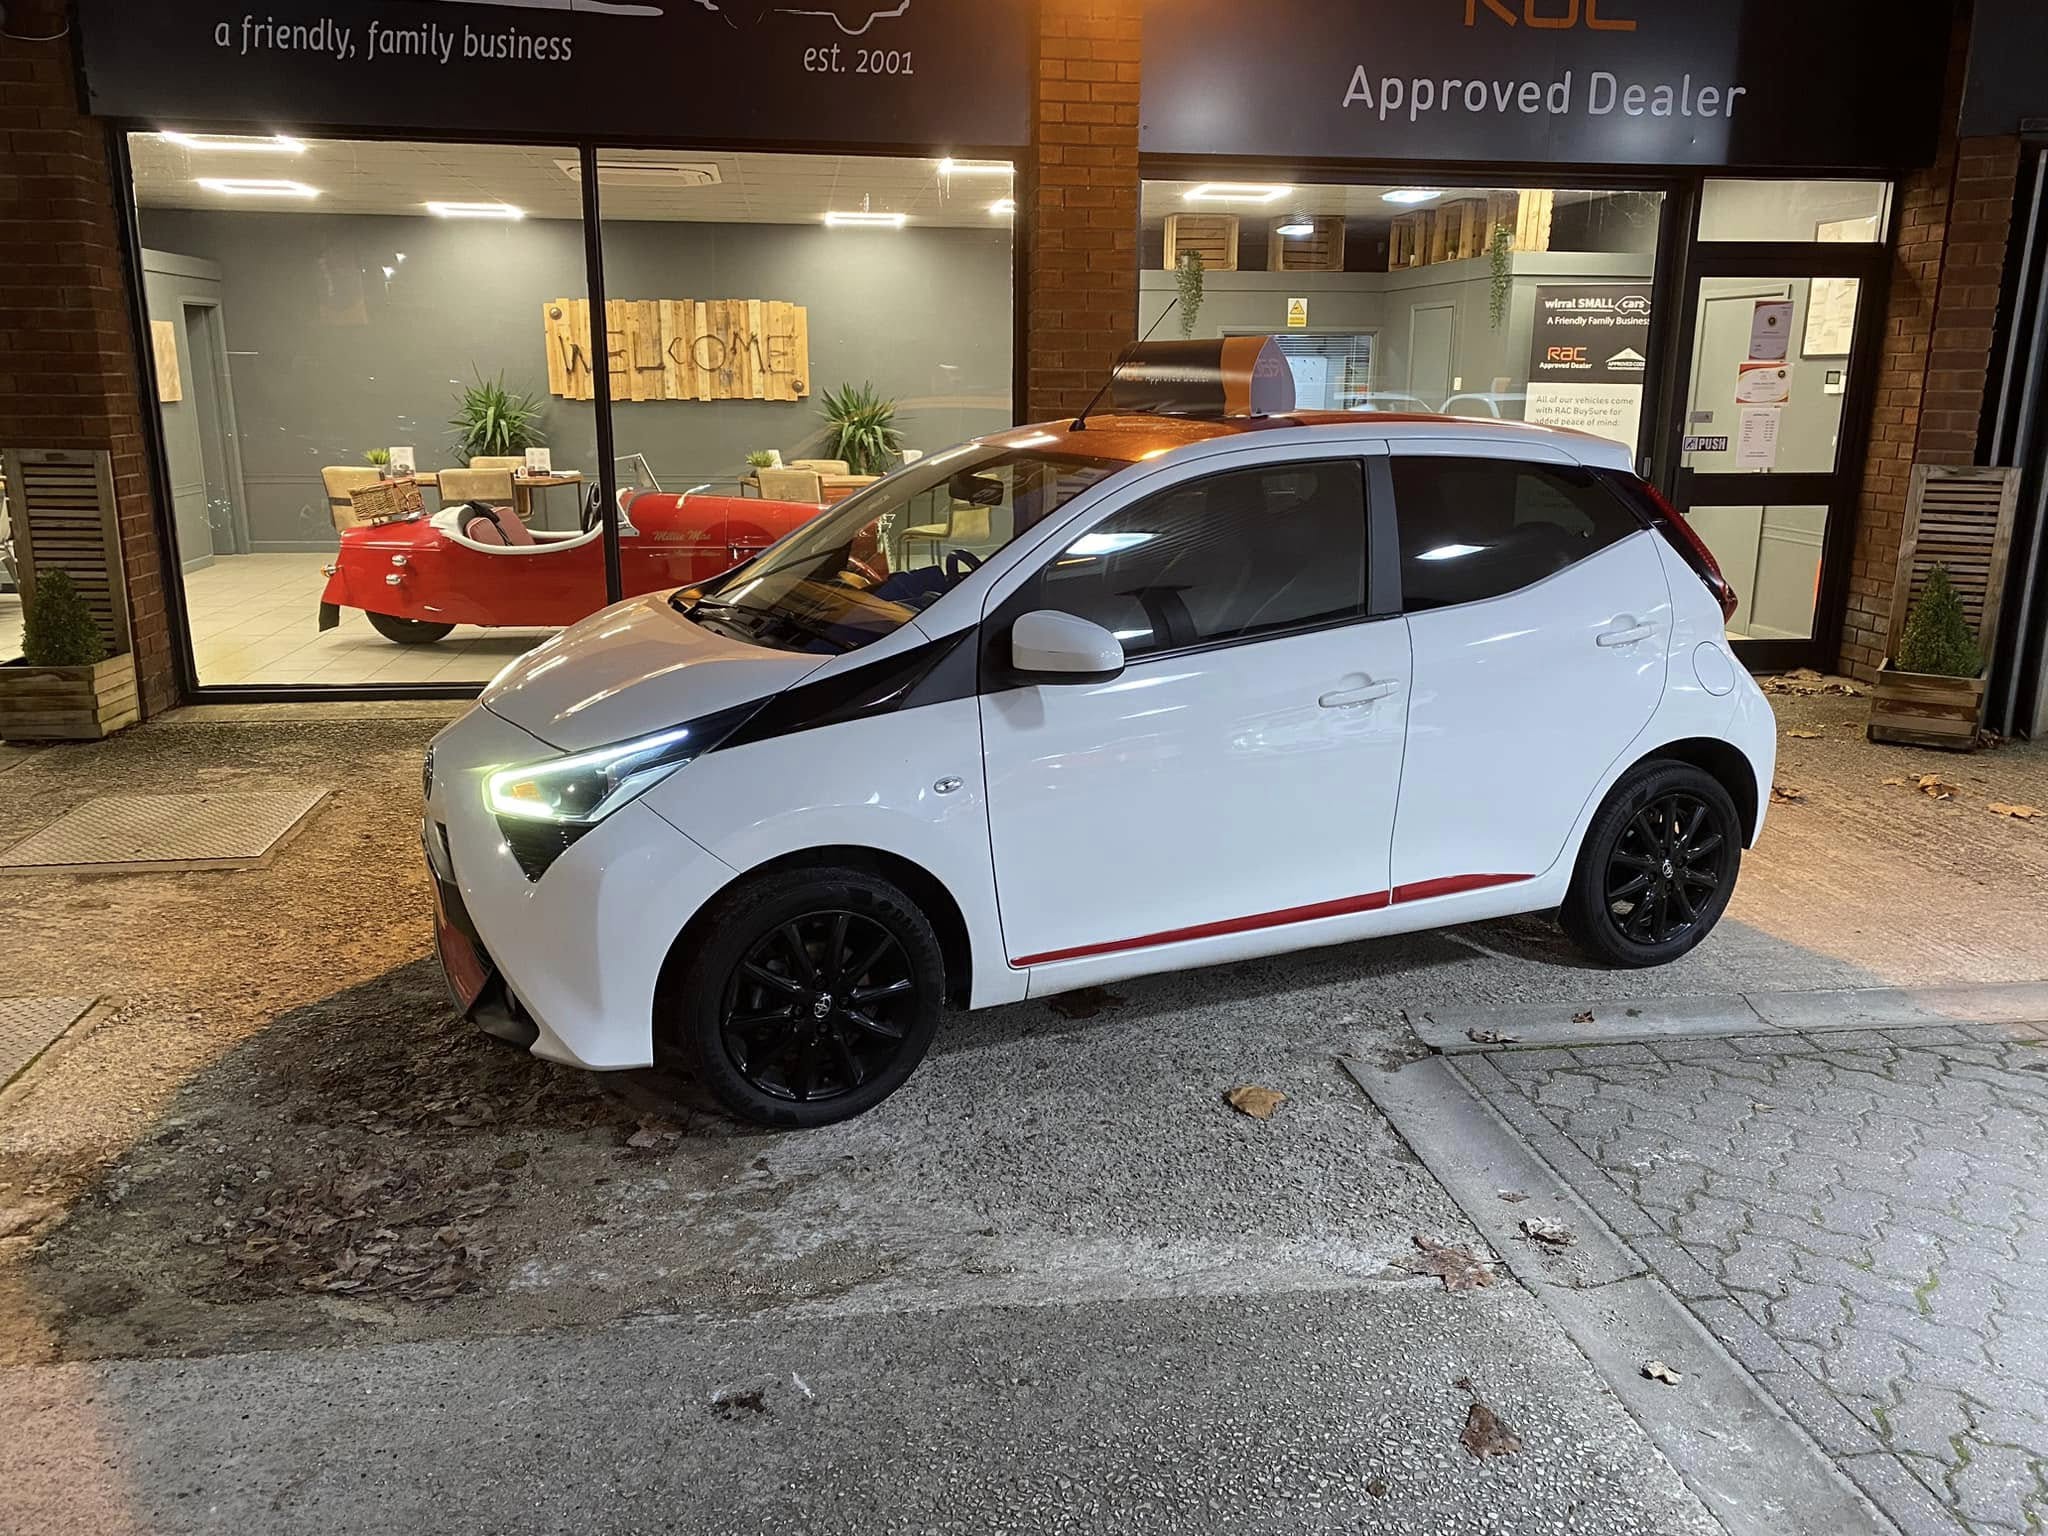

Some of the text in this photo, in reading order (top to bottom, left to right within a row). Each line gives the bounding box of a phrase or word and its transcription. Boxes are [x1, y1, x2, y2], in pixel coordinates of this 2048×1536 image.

[214, 15, 573, 64] a friendly, family business
[803, 43, 914, 75] est. 2001
[1342, 64, 1747, 121] Approved Dealer
[1544, 298, 1645, 309] wirral SMALL cars
[1546, 316, 1553, 325] A
[1554, 316, 1587, 327] Friendly
[1588, 316, 1616, 327] Family
[557, 328, 798, 376] WELCOME
[1539, 361, 1593, 370] Approved Dealer
[1536, 395, 1548, 404] All
[1549, 396, 1558, 404] of
[1575, 396, 1609, 405] vehicles
[1611, 398, 1634, 406] come
[1535, 406, 1622, 417] with RAC BuySure for
[1561, 418, 1585, 427] peace
[1586, 418, 1595, 426] of
[1698, 437, 1727, 451] PUSH
